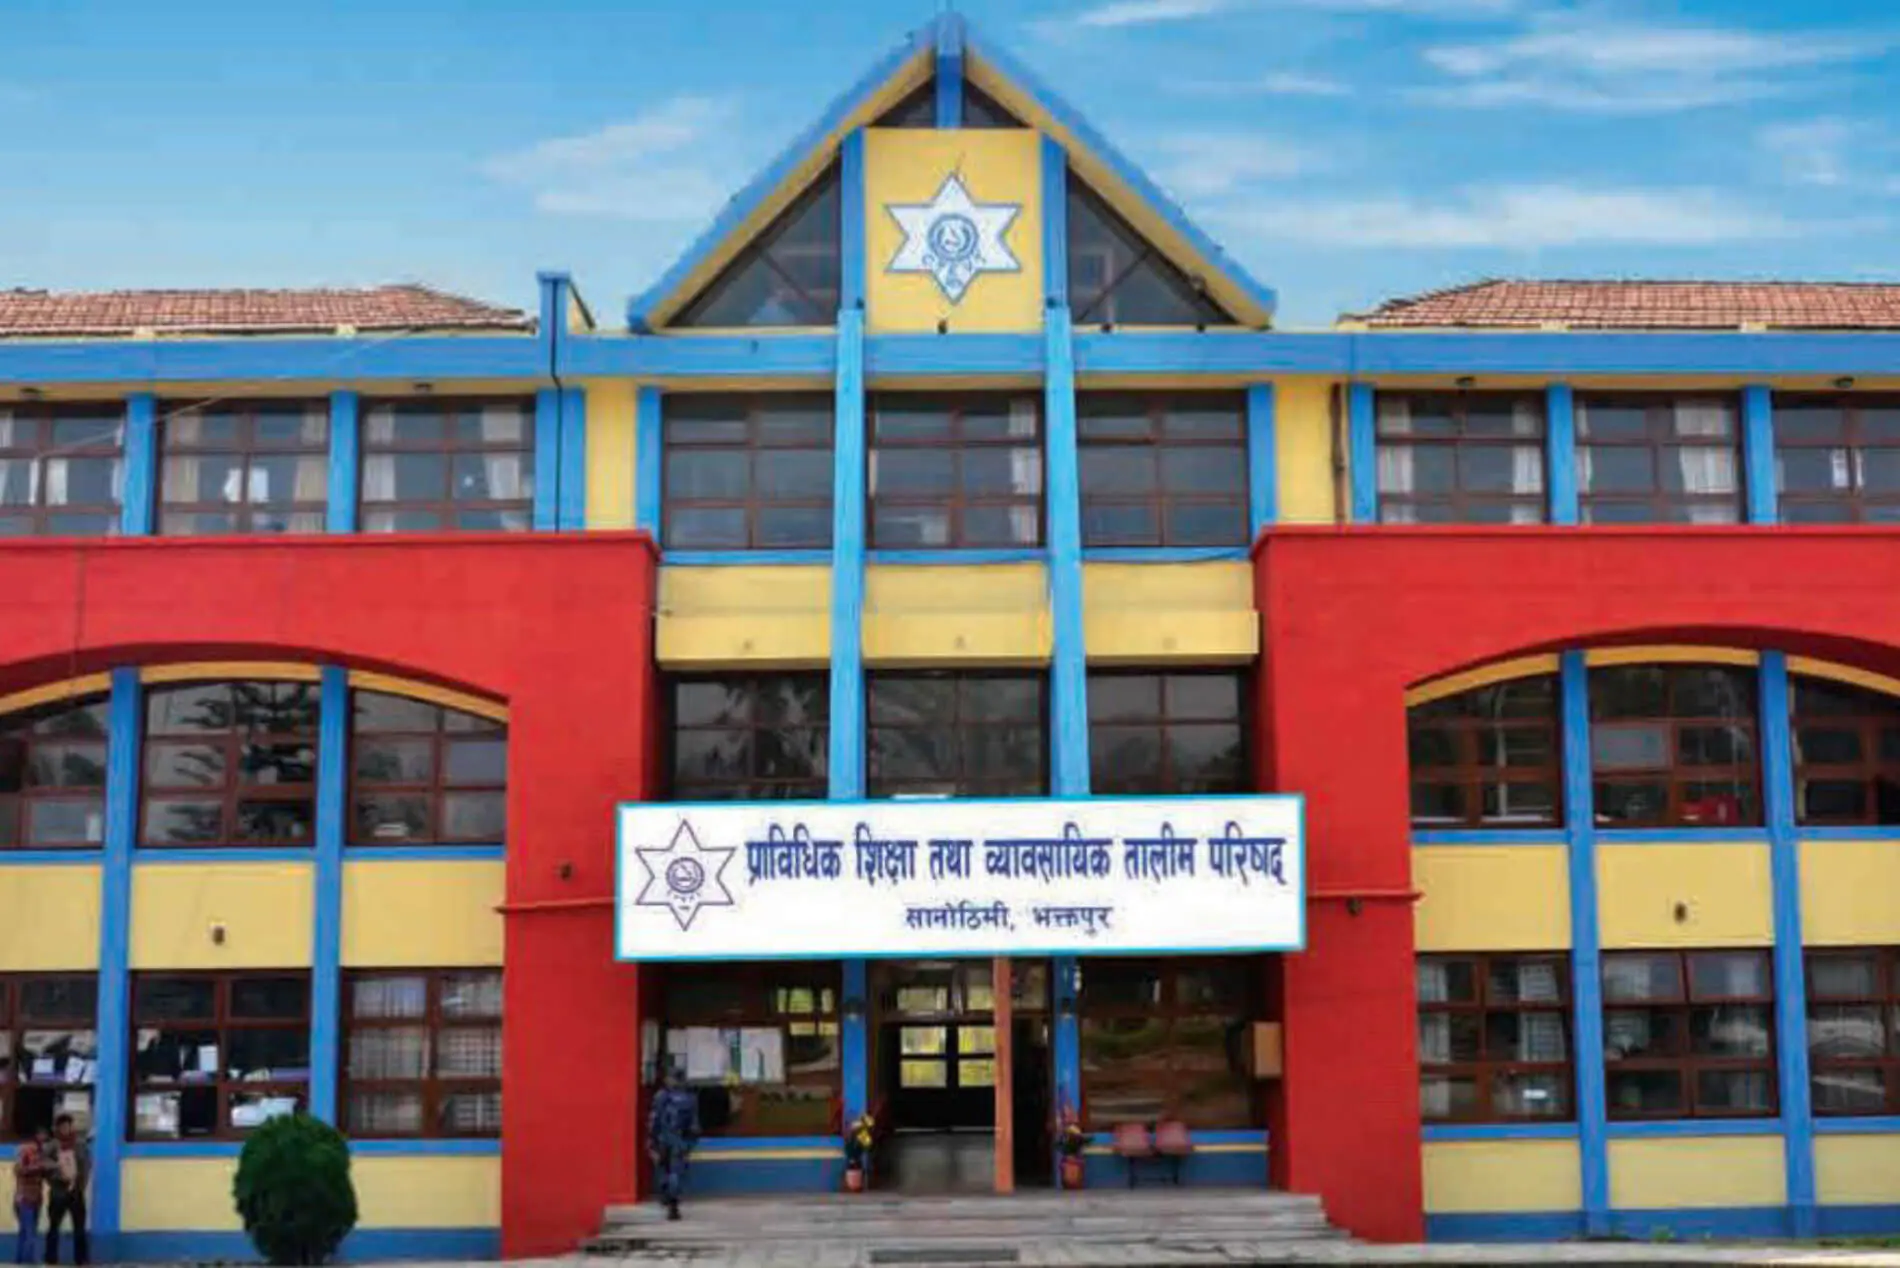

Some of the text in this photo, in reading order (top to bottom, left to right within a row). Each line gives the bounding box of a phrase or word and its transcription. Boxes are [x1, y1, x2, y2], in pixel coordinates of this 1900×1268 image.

[744, 822, 845, 886] प्राविधिक
[853, 821, 919, 886] शिक्षा
[927, 839, 974, 880] तथा
[982, 821, 1114, 884] व्यावसायिक
[1122, 821, 1199, 882] तालीम
[905, 899, 1114, 936] सानोठिमी, भक्तपुर
